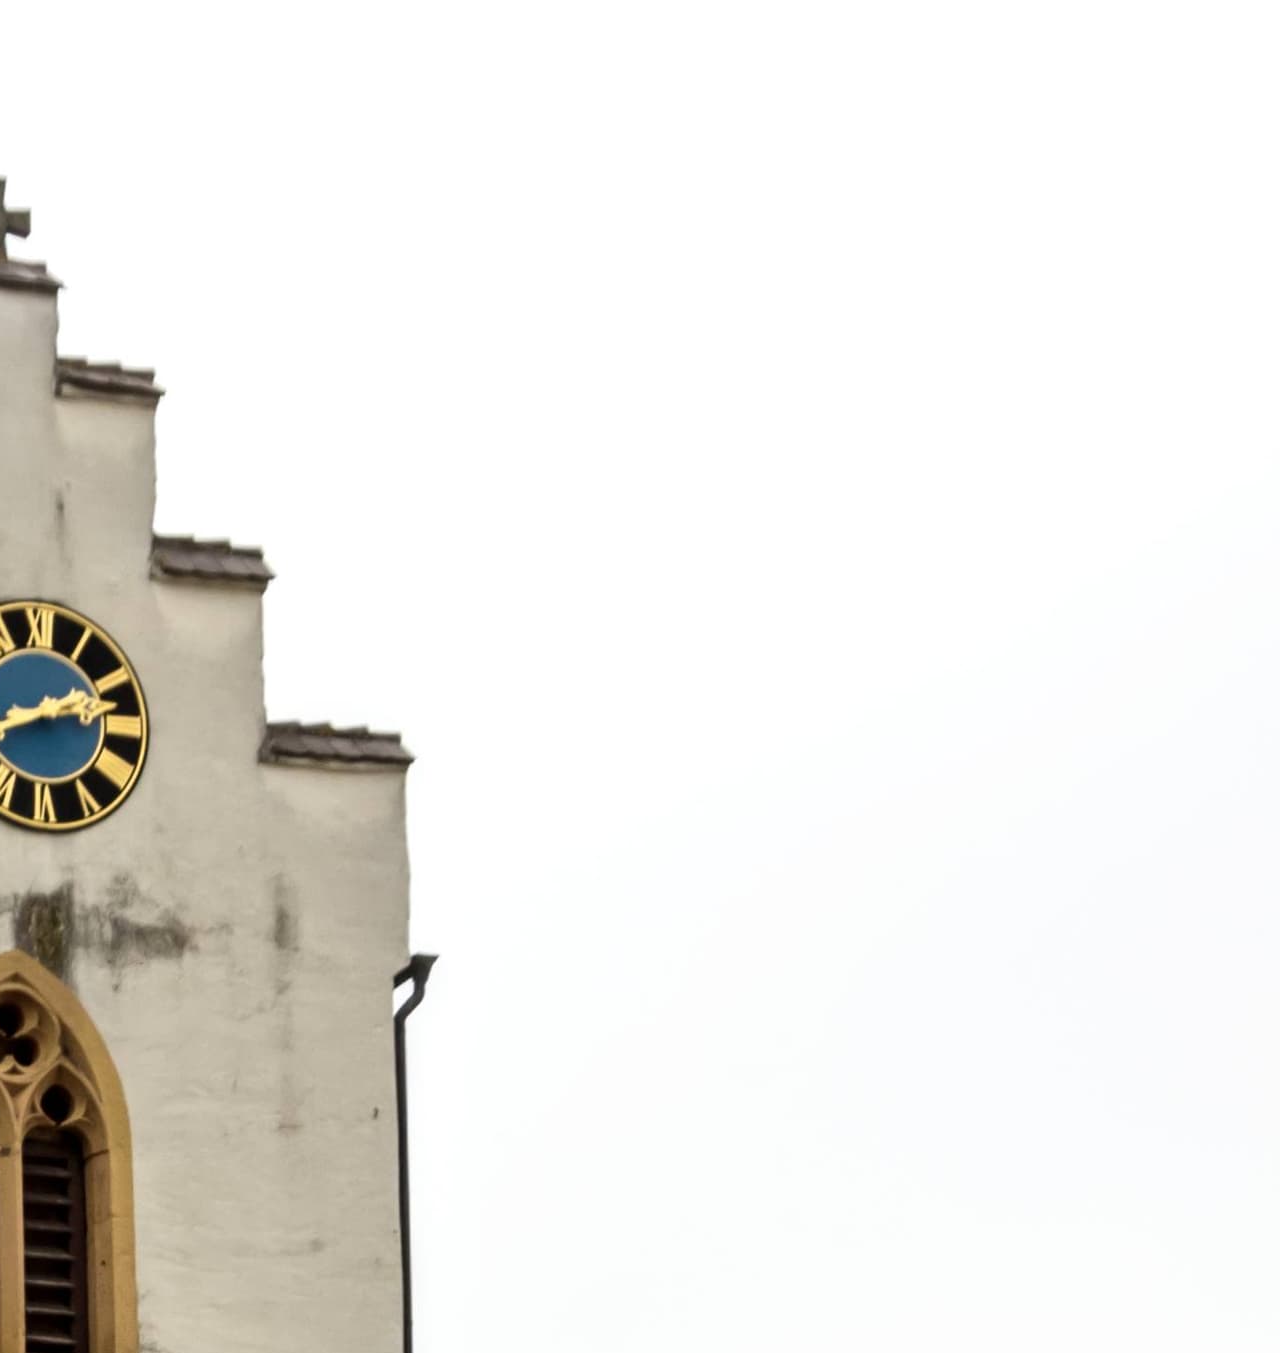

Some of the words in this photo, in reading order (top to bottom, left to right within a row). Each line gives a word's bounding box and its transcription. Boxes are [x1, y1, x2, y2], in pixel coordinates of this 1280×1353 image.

[25, 608, 55, 648] XII
[70, 626, 93, 662] I
[95, 665, 130, 693] II
[34, 783, 57, 822] VI
[75, 778, 102, 817] V
